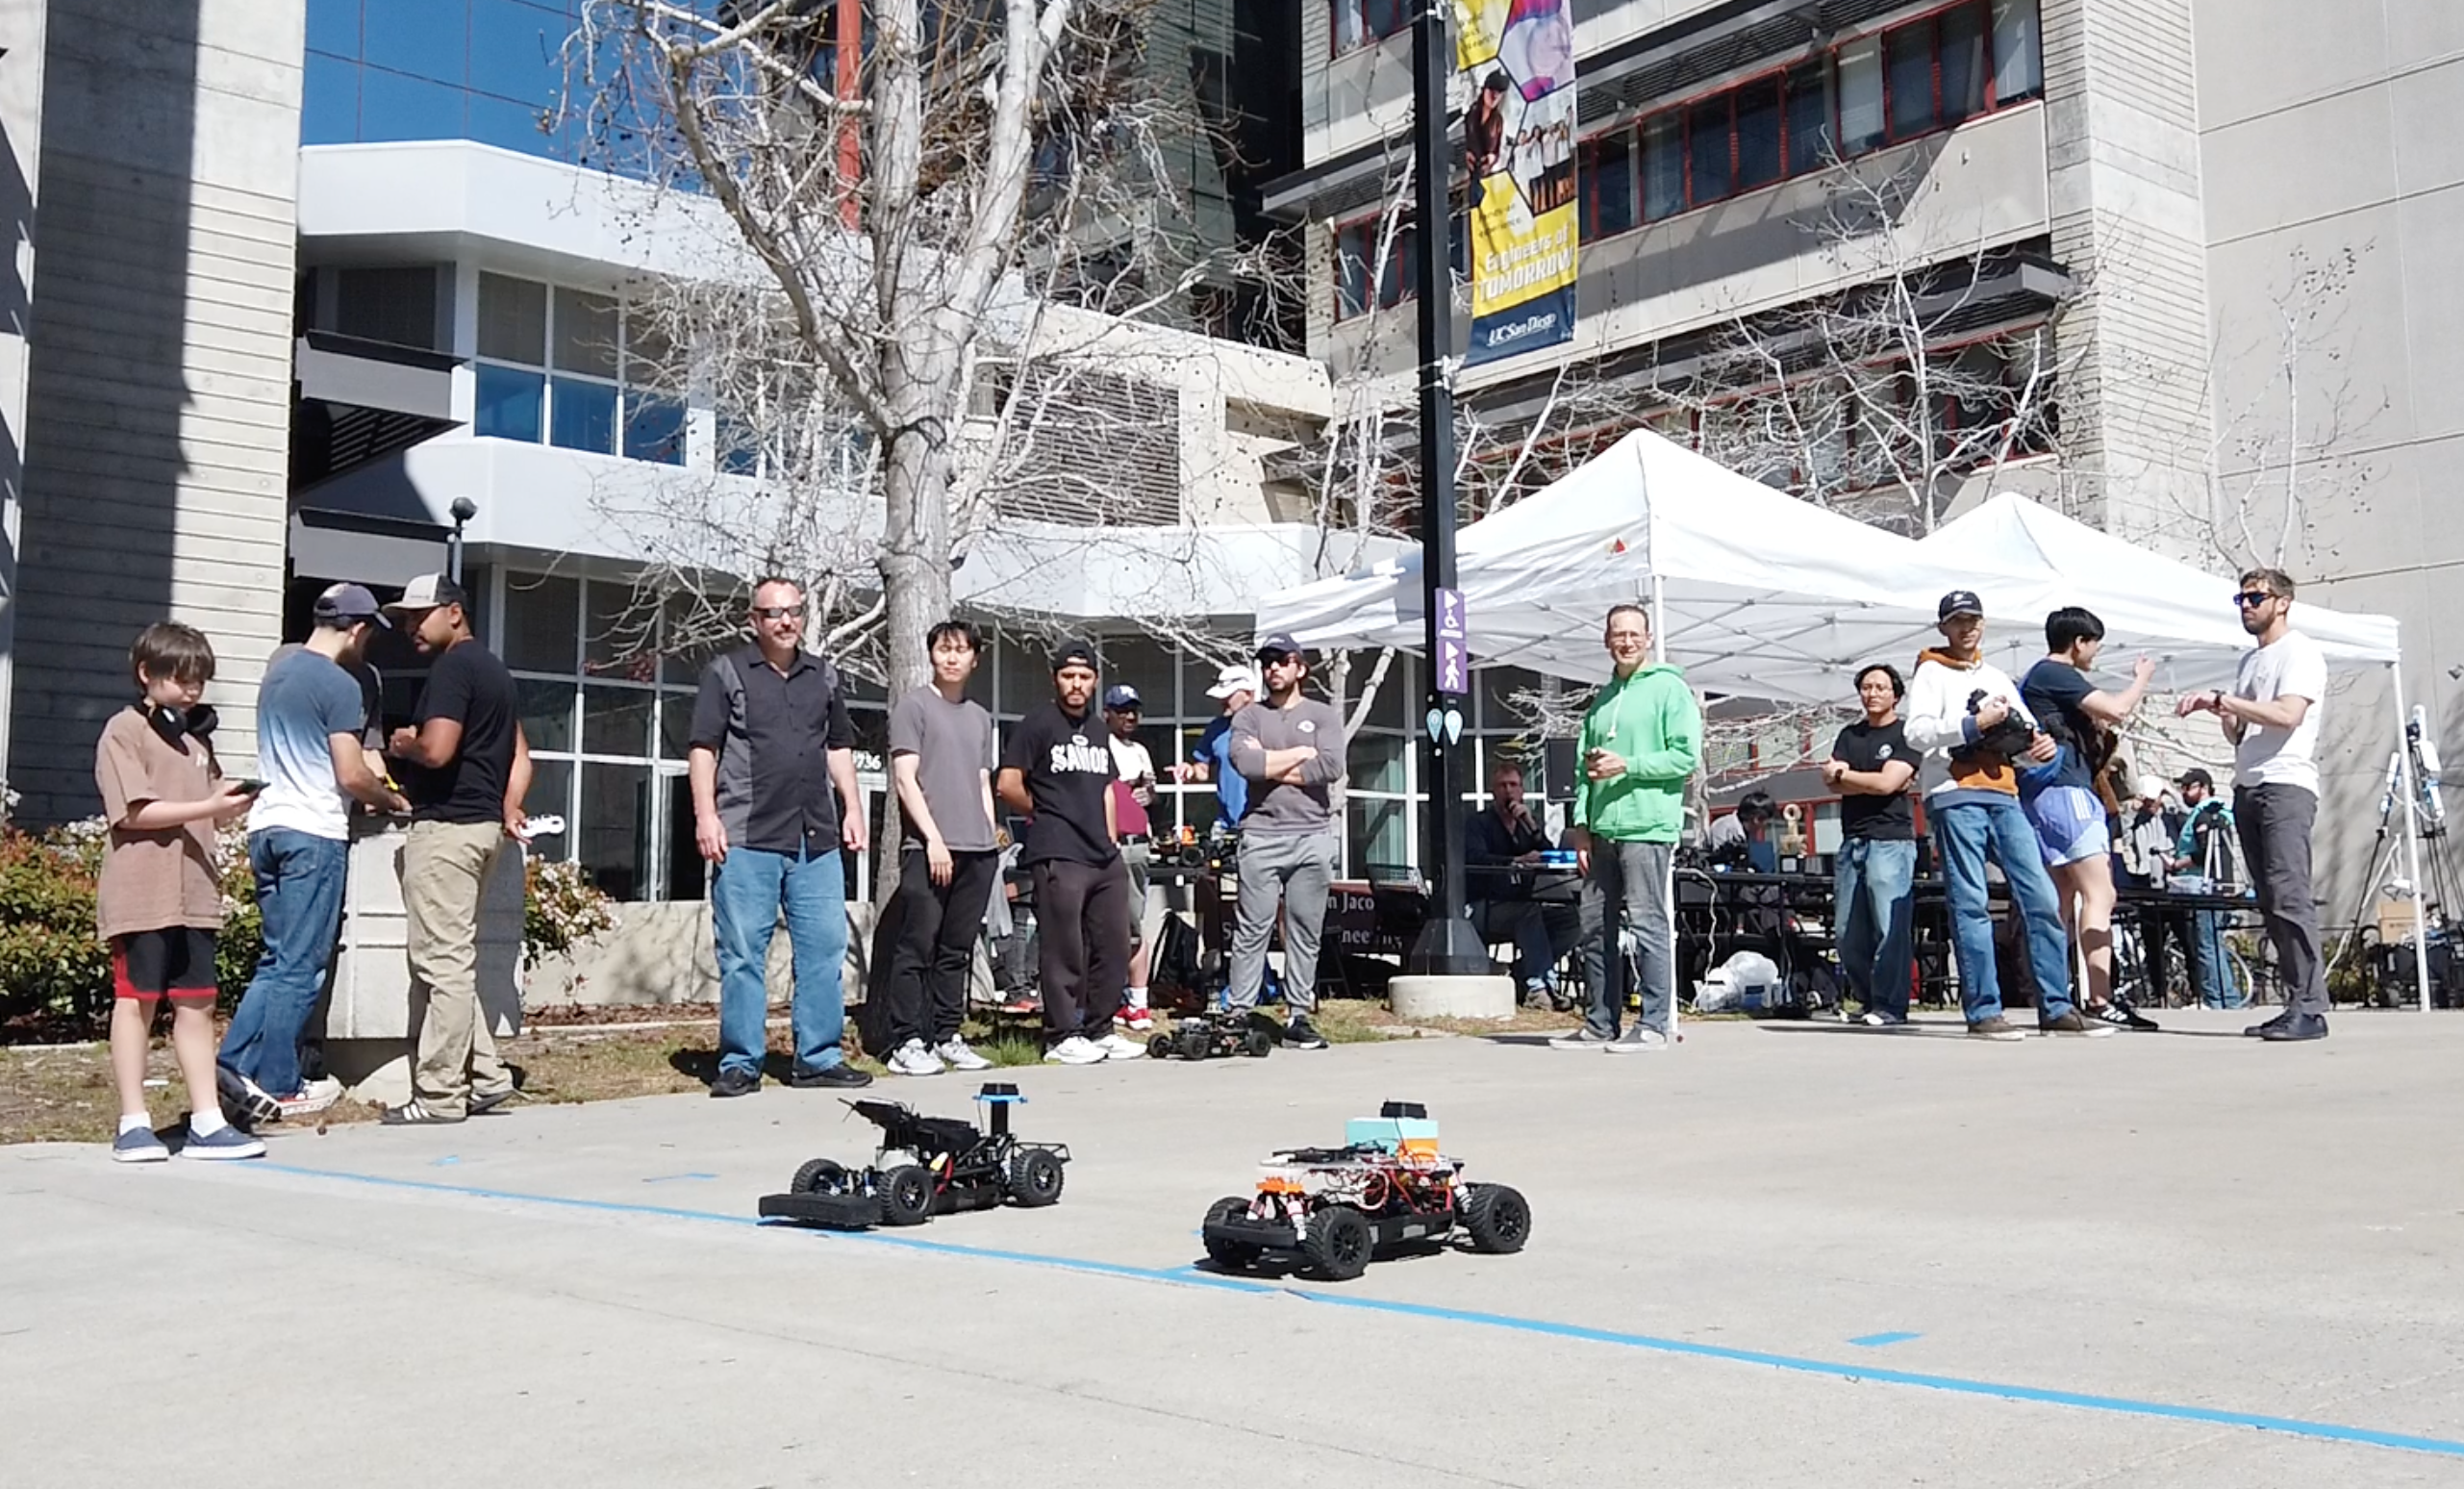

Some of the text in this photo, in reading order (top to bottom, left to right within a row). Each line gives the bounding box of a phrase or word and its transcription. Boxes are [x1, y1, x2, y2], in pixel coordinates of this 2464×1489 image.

[1485, 235, 1552, 272] Engineers
[1556, 222, 1570, 244] of
[1478, 245, 1574, 302] TOMORROW
[1488, 313, 1556, 343] UC San Diego
[1341, 892, 1375, 915] Jaco
